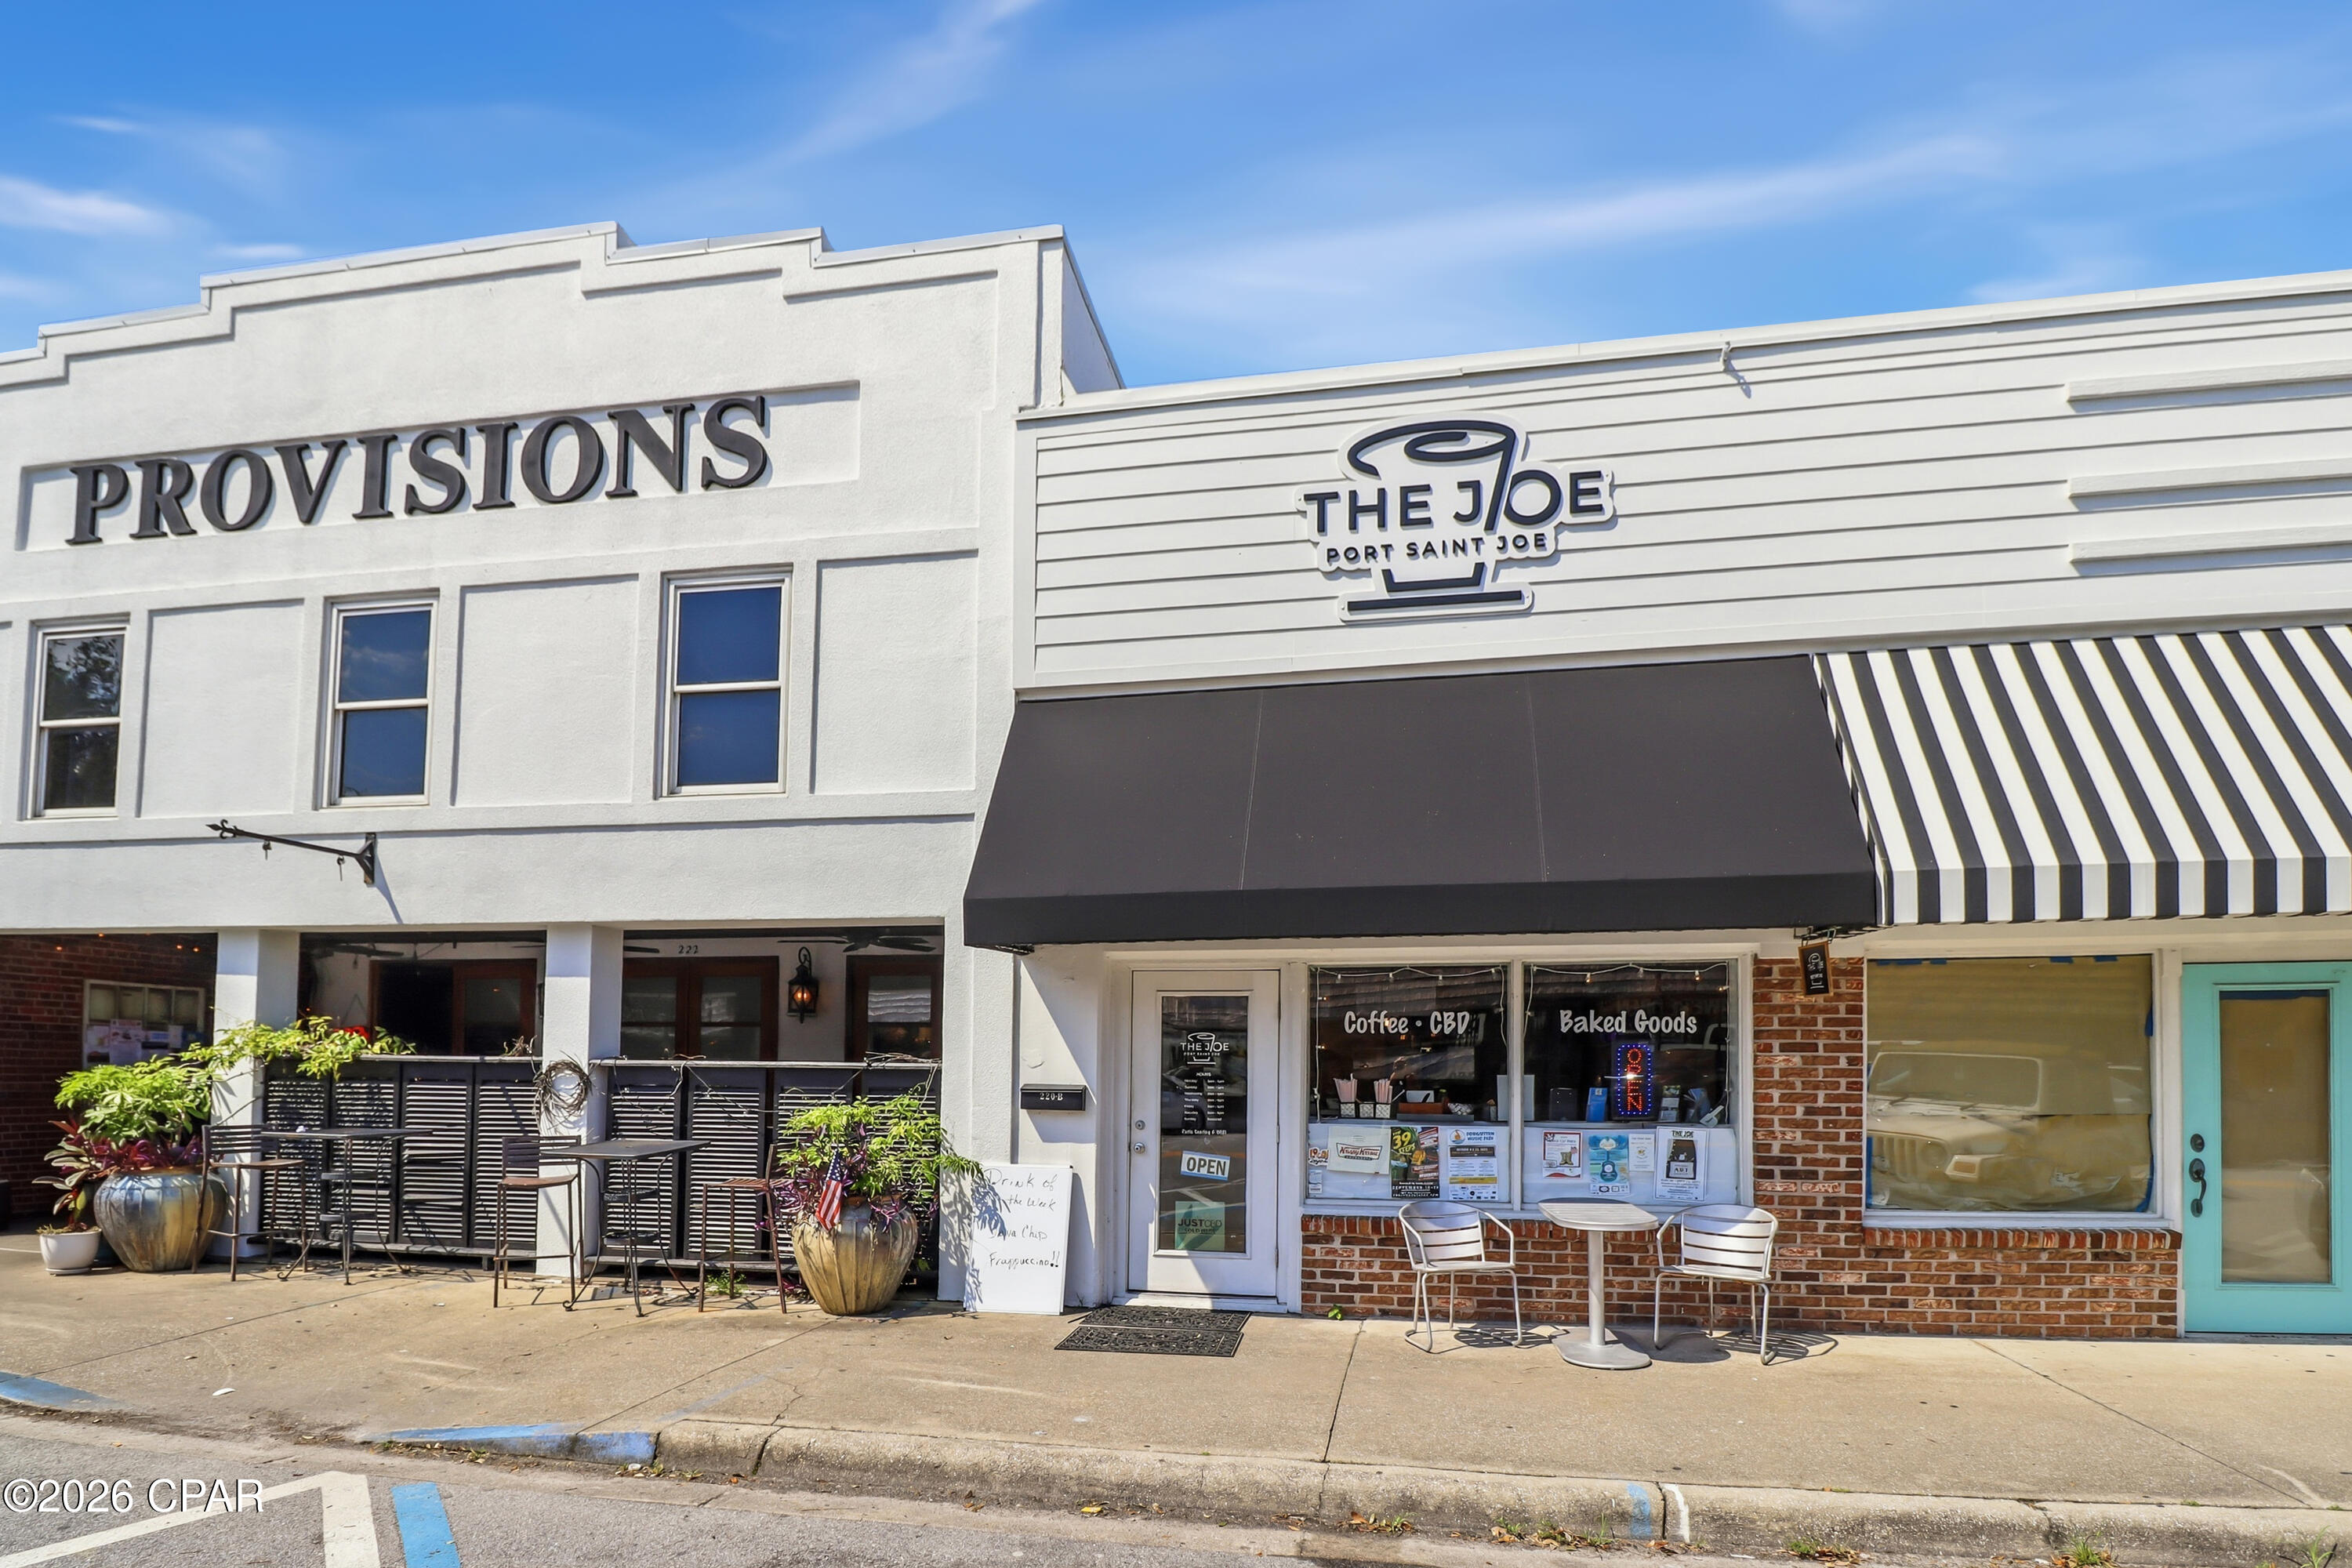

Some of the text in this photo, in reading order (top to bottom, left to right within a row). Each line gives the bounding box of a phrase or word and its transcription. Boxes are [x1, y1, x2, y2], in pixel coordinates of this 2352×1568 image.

[64, 395, 769, 546] PROVISIONS
[1304, 470, 1603, 534] THE JOE
[1327, 532, 1547, 563] PORT SAINT JOE
[1344, 1010, 1470, 1035] Coffee CBD
[1559, 1009, 1697, 1033] Baked Goods
[1205, 1042, 1229, 1051] JOE
[1627, 1048, 1642, 1111] OPEN
[1392, 1131, 1411, 1149] 39
[1186, 1156, 1226, 1176] OPEN
[1043, 1174, 1058, 1192] of
[1007, 1194, 1022, 1205] the
